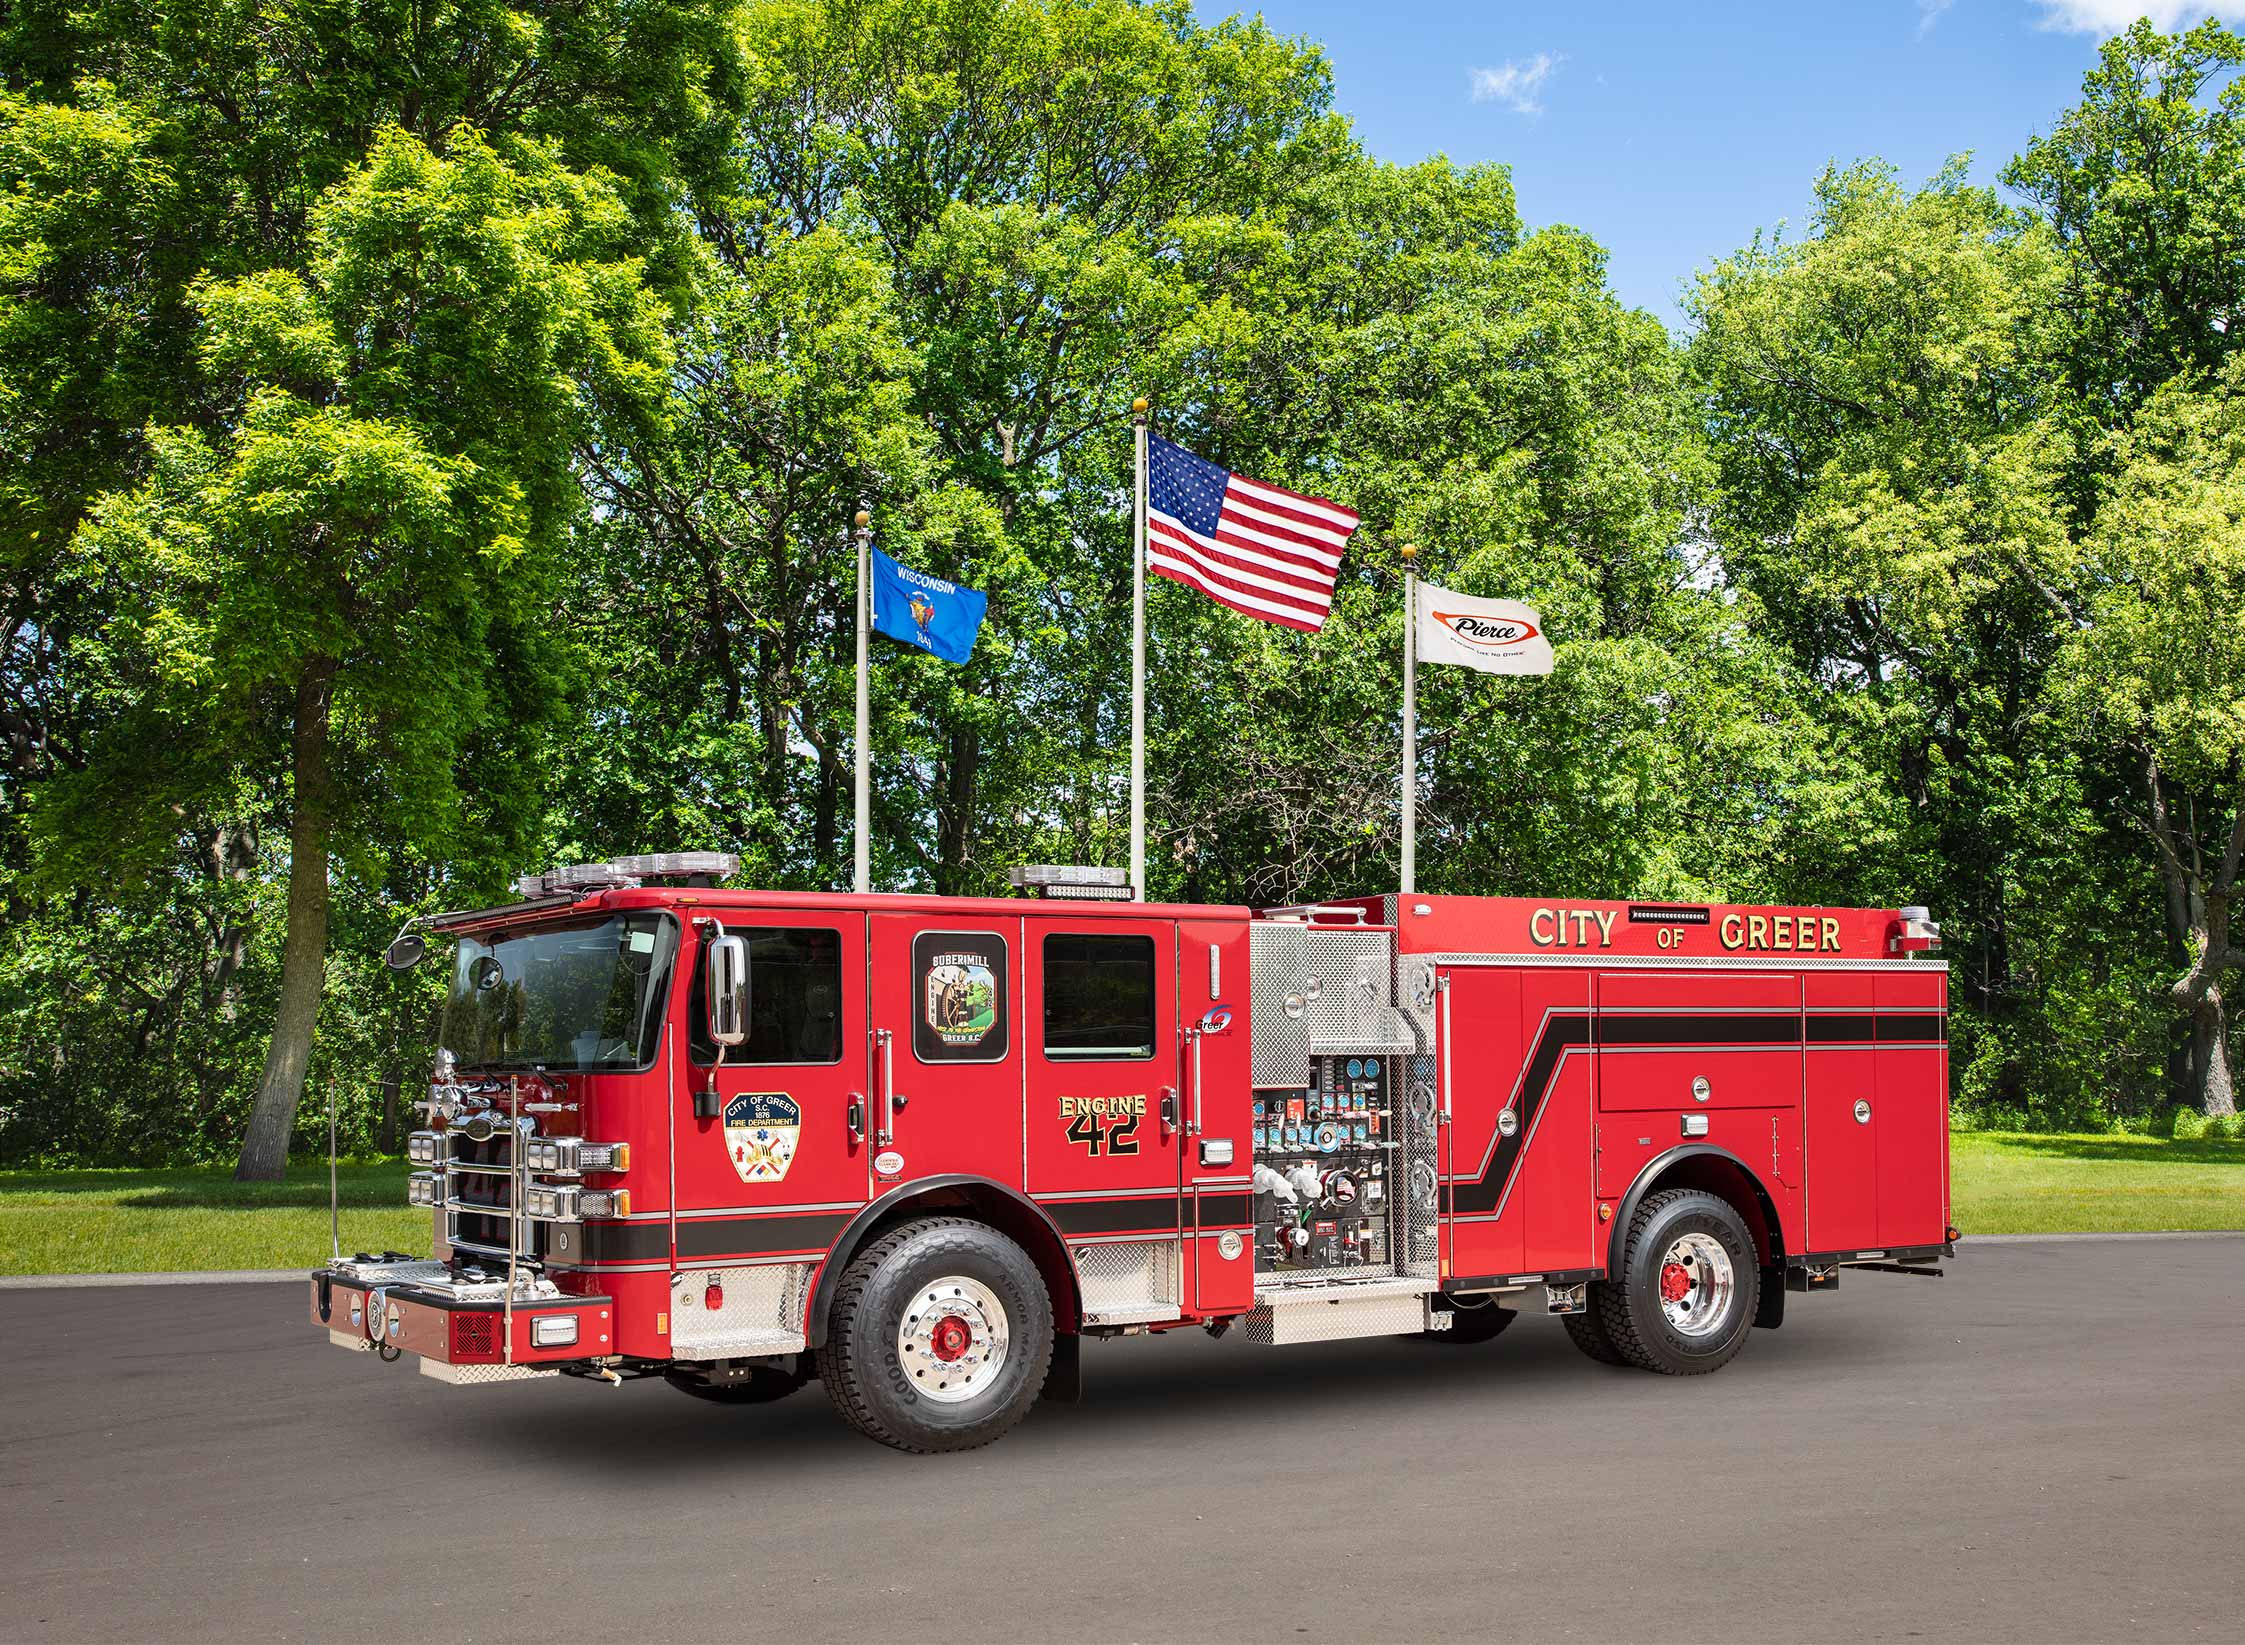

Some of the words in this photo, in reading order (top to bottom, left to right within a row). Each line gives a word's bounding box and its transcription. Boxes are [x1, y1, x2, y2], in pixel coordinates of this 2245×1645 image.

[897, 566, 956, 595] WISCONSIN
[1455, 618, 1516, 639] Pierce
[1530, 907, 1619, 947] CITY
[1656, 927, 1685, 950] OF
[1719, 912, 1841, 952] GREER
[967, 954, 990, 968] MILL
[1195, 1019, 1224, 1030] Greer
[727, 1099, 747, 1117] CITY
[750, 1096, 763, 1105] OF
[766, 1096, 797, 1116] GREER
[755, 1104, 770, 1112] S.C.
[755, 1111, 770, 1119] 1876
[1057, 1093, 1147, 1120] ENGINE
[730, 1119, 746, 1127] FIRE
[748, 1118, 794, 1127] DEPARTMENT
[1065, 1113, 1140, 1157] 42
[998, 1273, 1028, 1326] ARMOR
